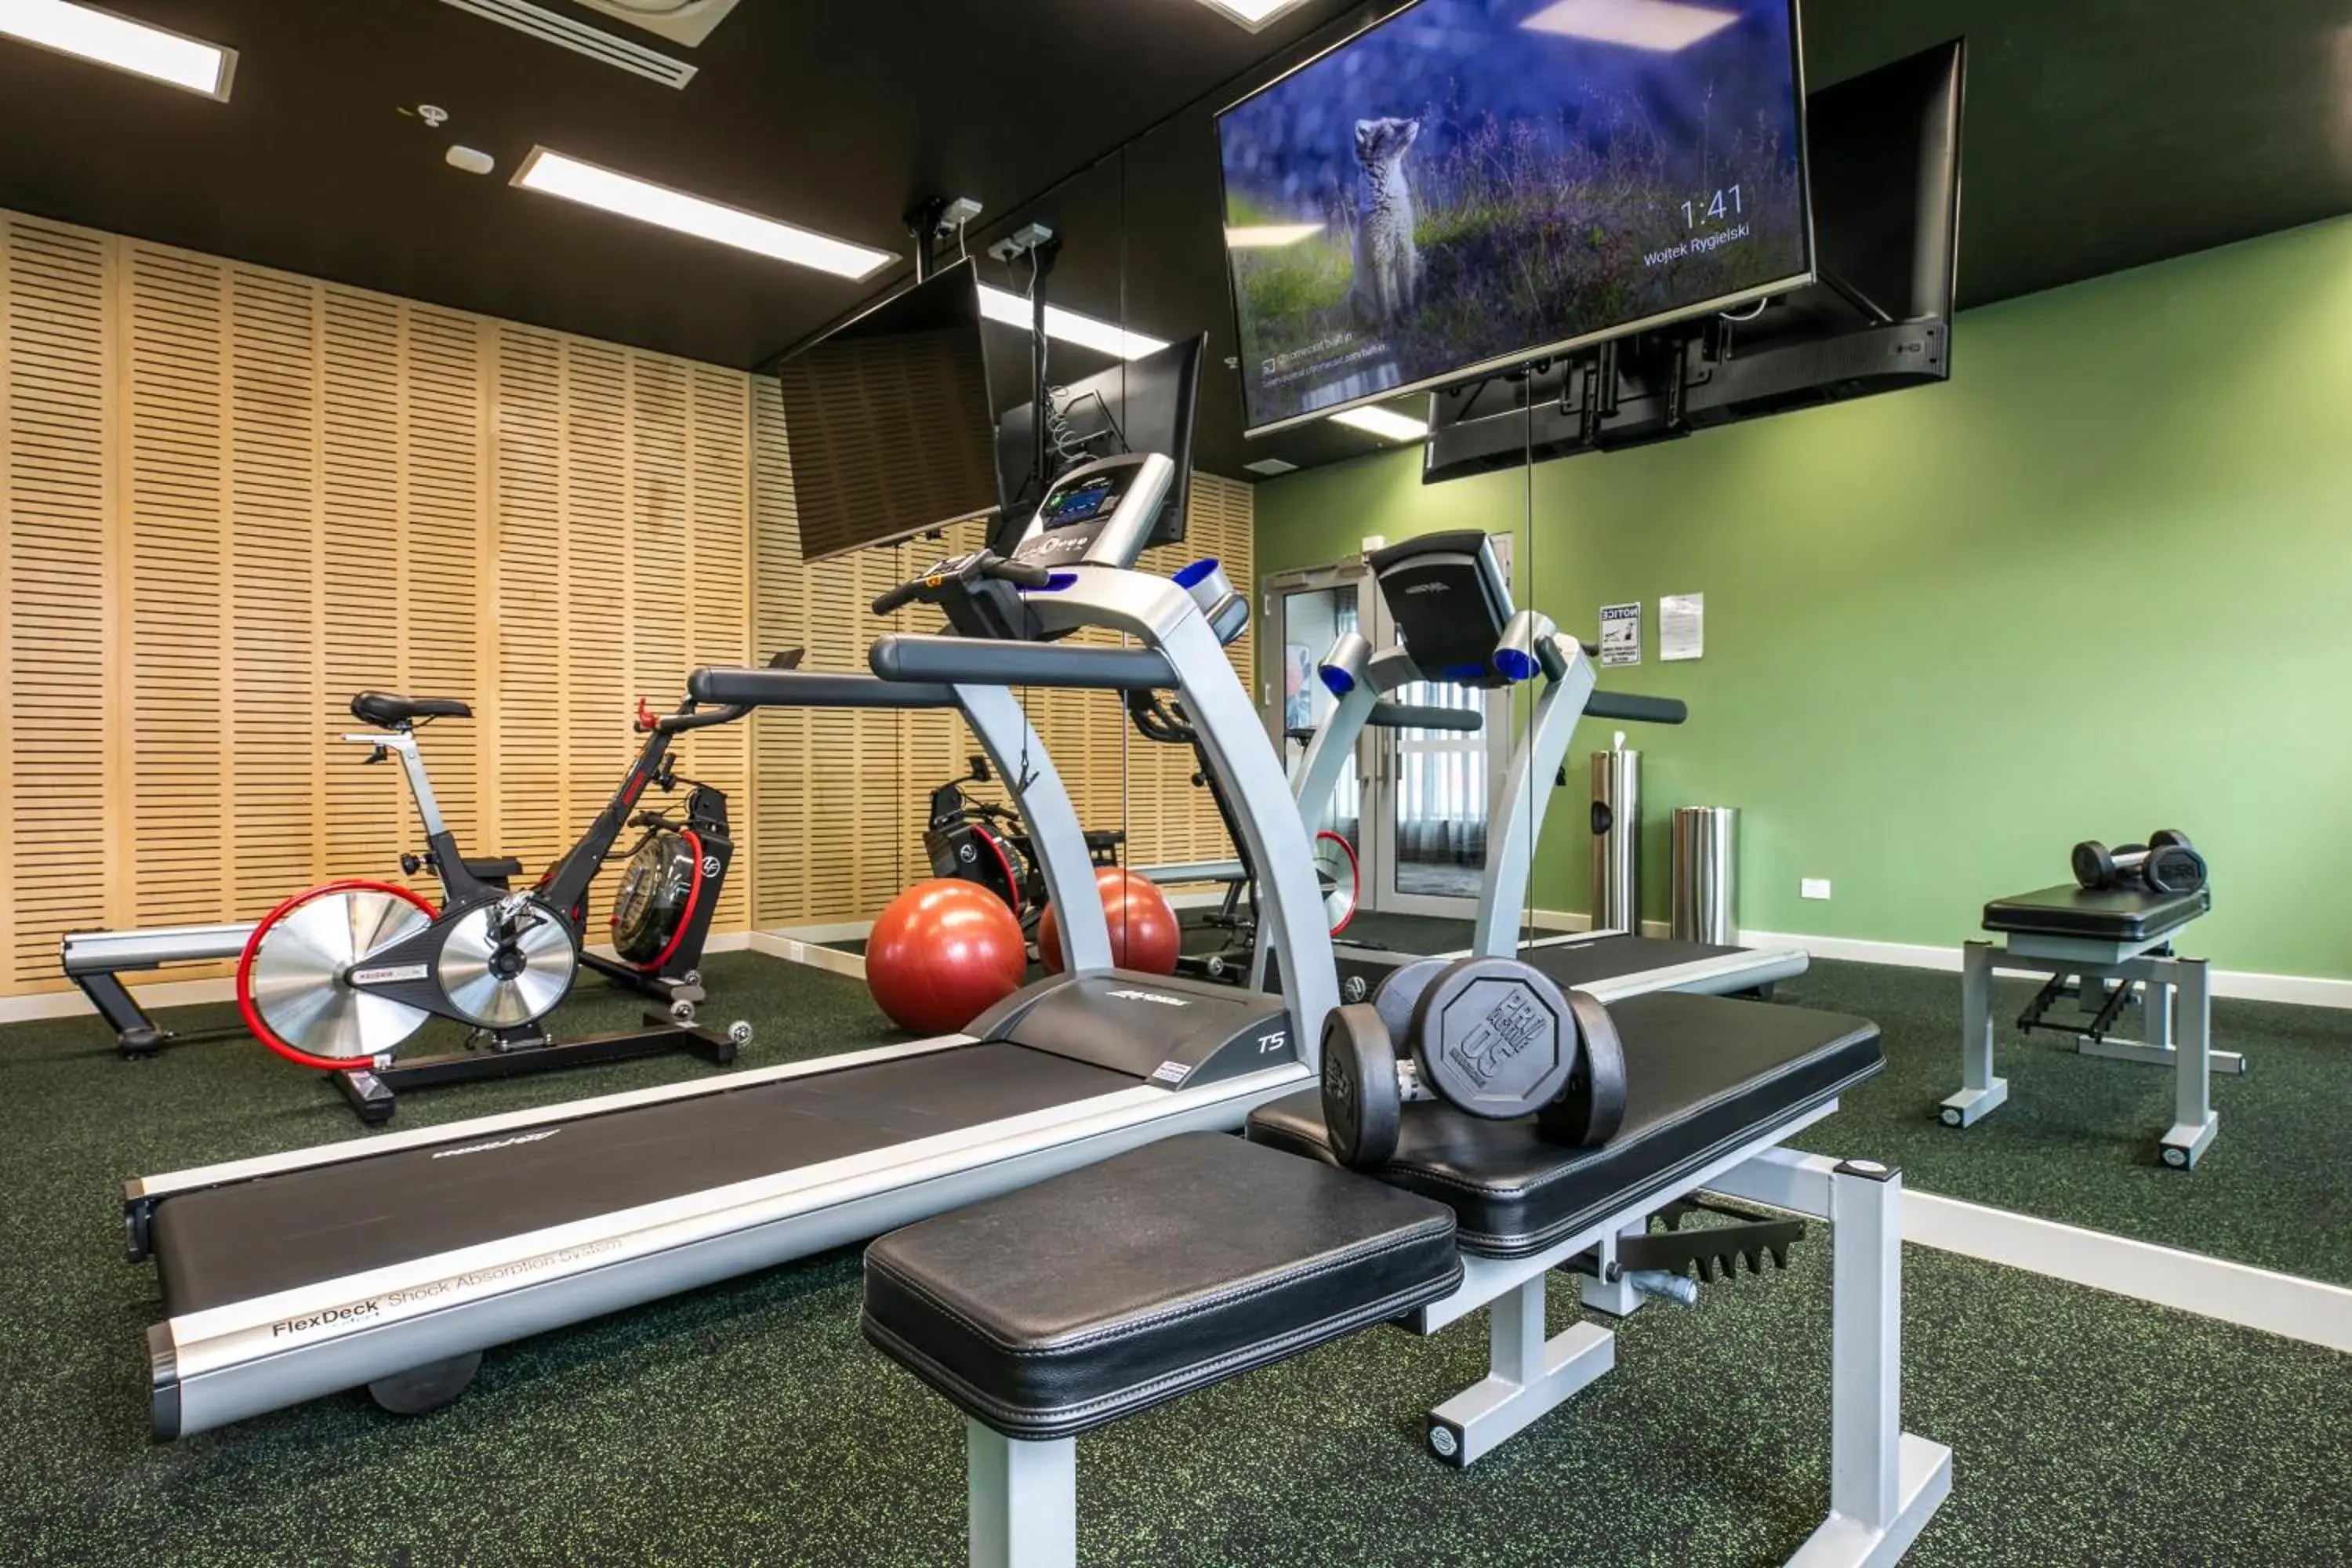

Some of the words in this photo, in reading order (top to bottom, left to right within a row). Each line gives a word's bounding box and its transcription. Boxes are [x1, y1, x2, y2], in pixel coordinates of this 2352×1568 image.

[1681, 183, 1741, 228] 1:41
[1643, 244, 1688, 267] Wojtek
[1691, 223, 1750, 252] Rygielski
[271, 1301, 379, 1338] FlexDeck
[388, 1282, 451, 1307] Shock
[456, 1256, 556, 1290] Absorption
[559, 1238, 623, 1263] System
